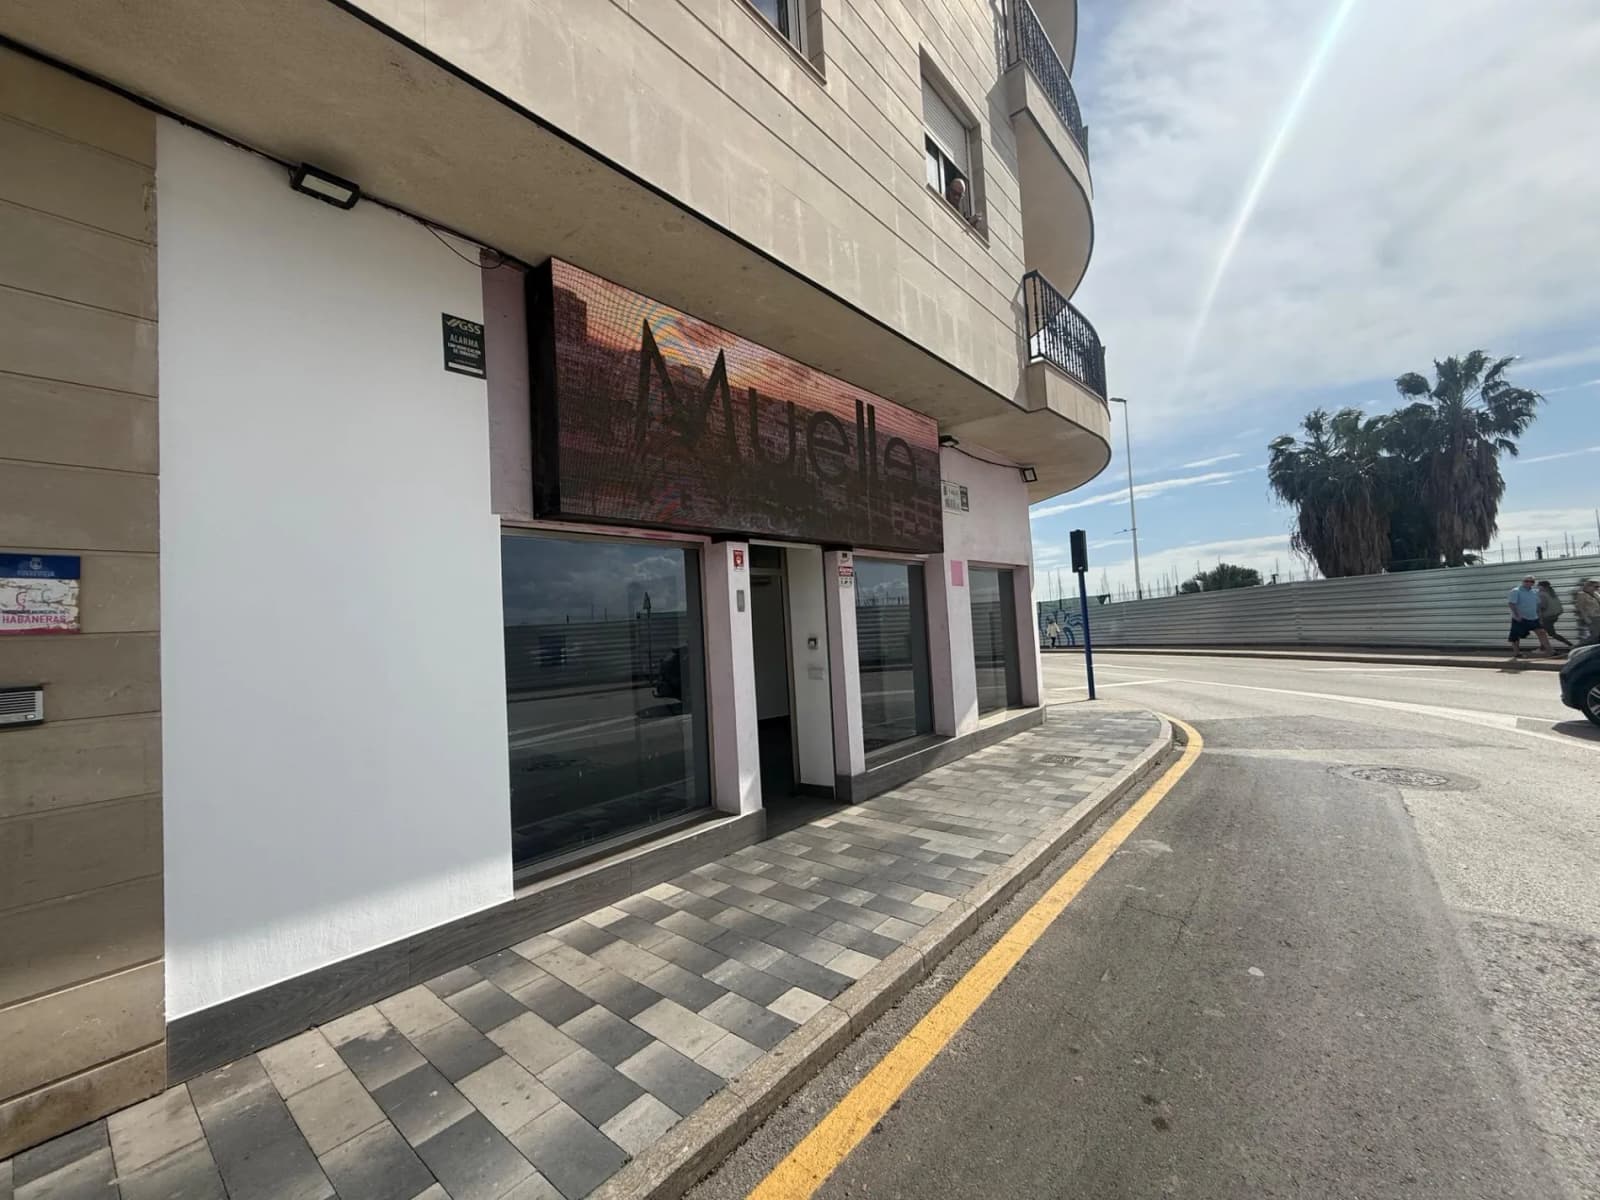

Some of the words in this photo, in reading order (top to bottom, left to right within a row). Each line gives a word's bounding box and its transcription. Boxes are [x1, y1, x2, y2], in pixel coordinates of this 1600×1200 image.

[458, 321, 481, 335] GSS
[449, 333, 479, 348] ALARMA
[636, 318, 919, 496] Muelle
[2, 615, 66, 625] HABANERAS
